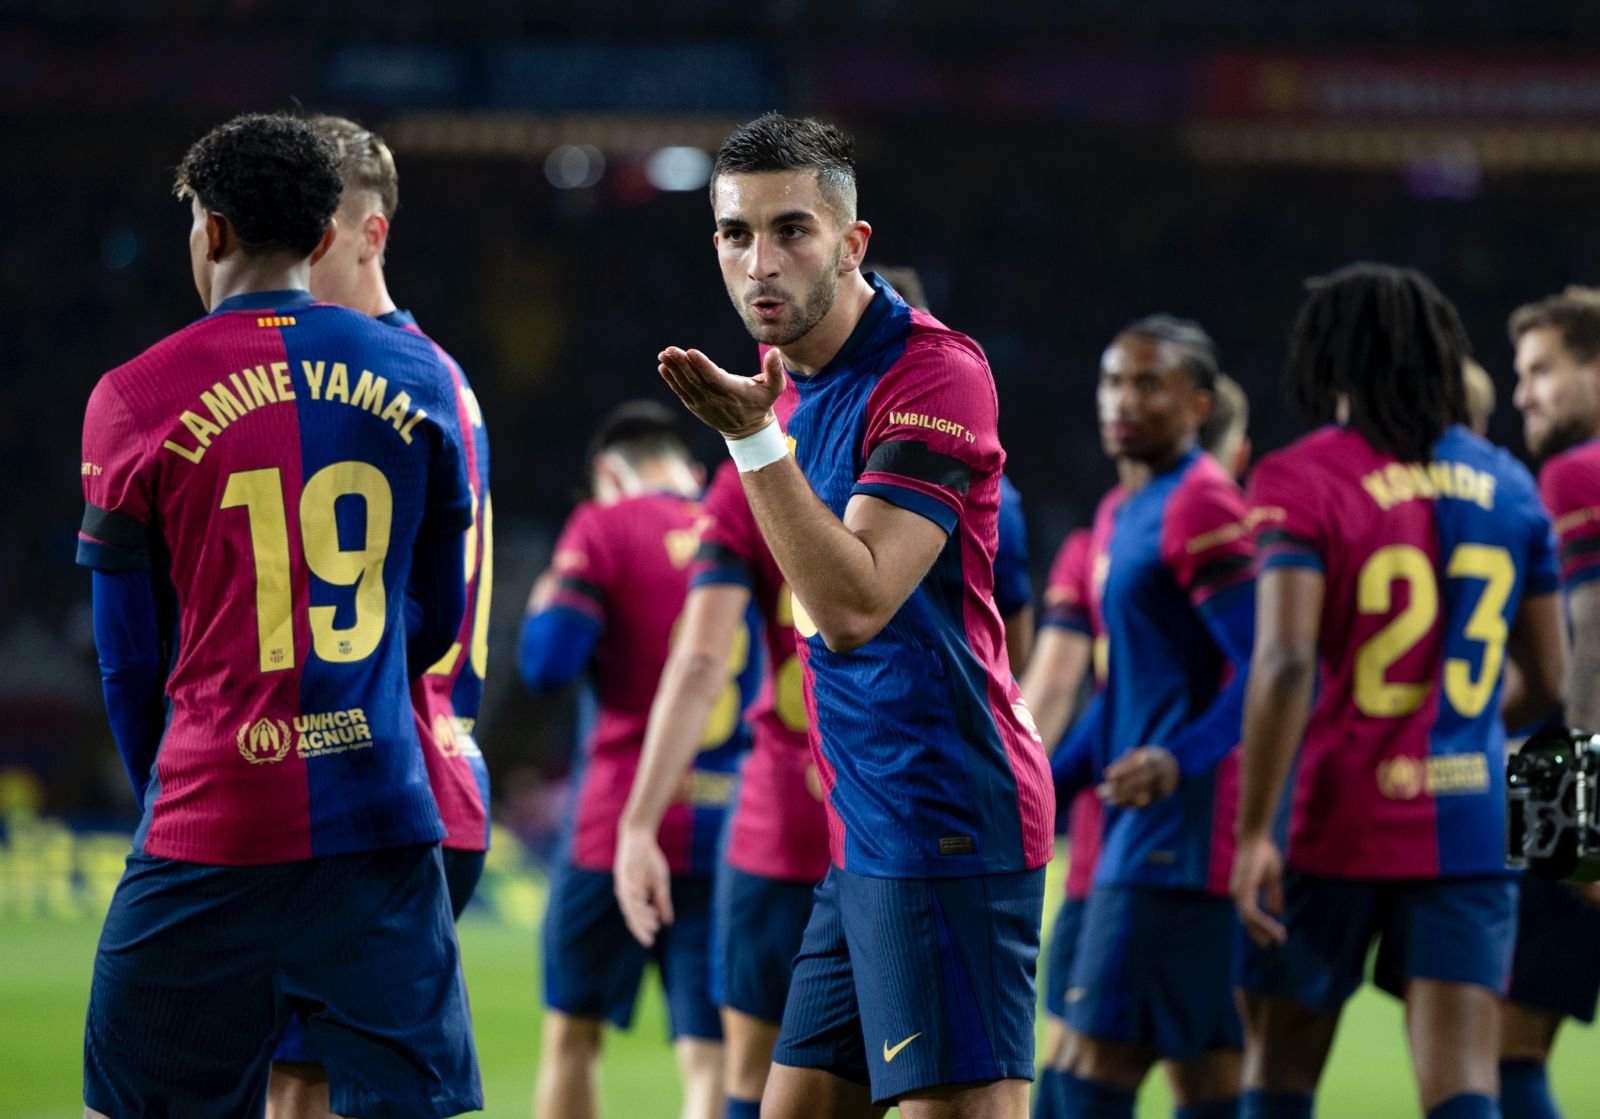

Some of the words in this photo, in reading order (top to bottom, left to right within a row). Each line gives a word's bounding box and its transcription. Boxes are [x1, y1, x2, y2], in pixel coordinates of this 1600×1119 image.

[163, 362, 296, 464] LAMINE
[301, 360, 428, 445] YAMAL
[889, 411, 965, 438] AMBILIGHT
[965, 430, 976, 444] tv
[219, 460, 393, 673] 19
[1354, 543, 1515, 718] 23
[293, 708, 367, 732] UNHCR
[296, 723, 372, 751] ACNUR
